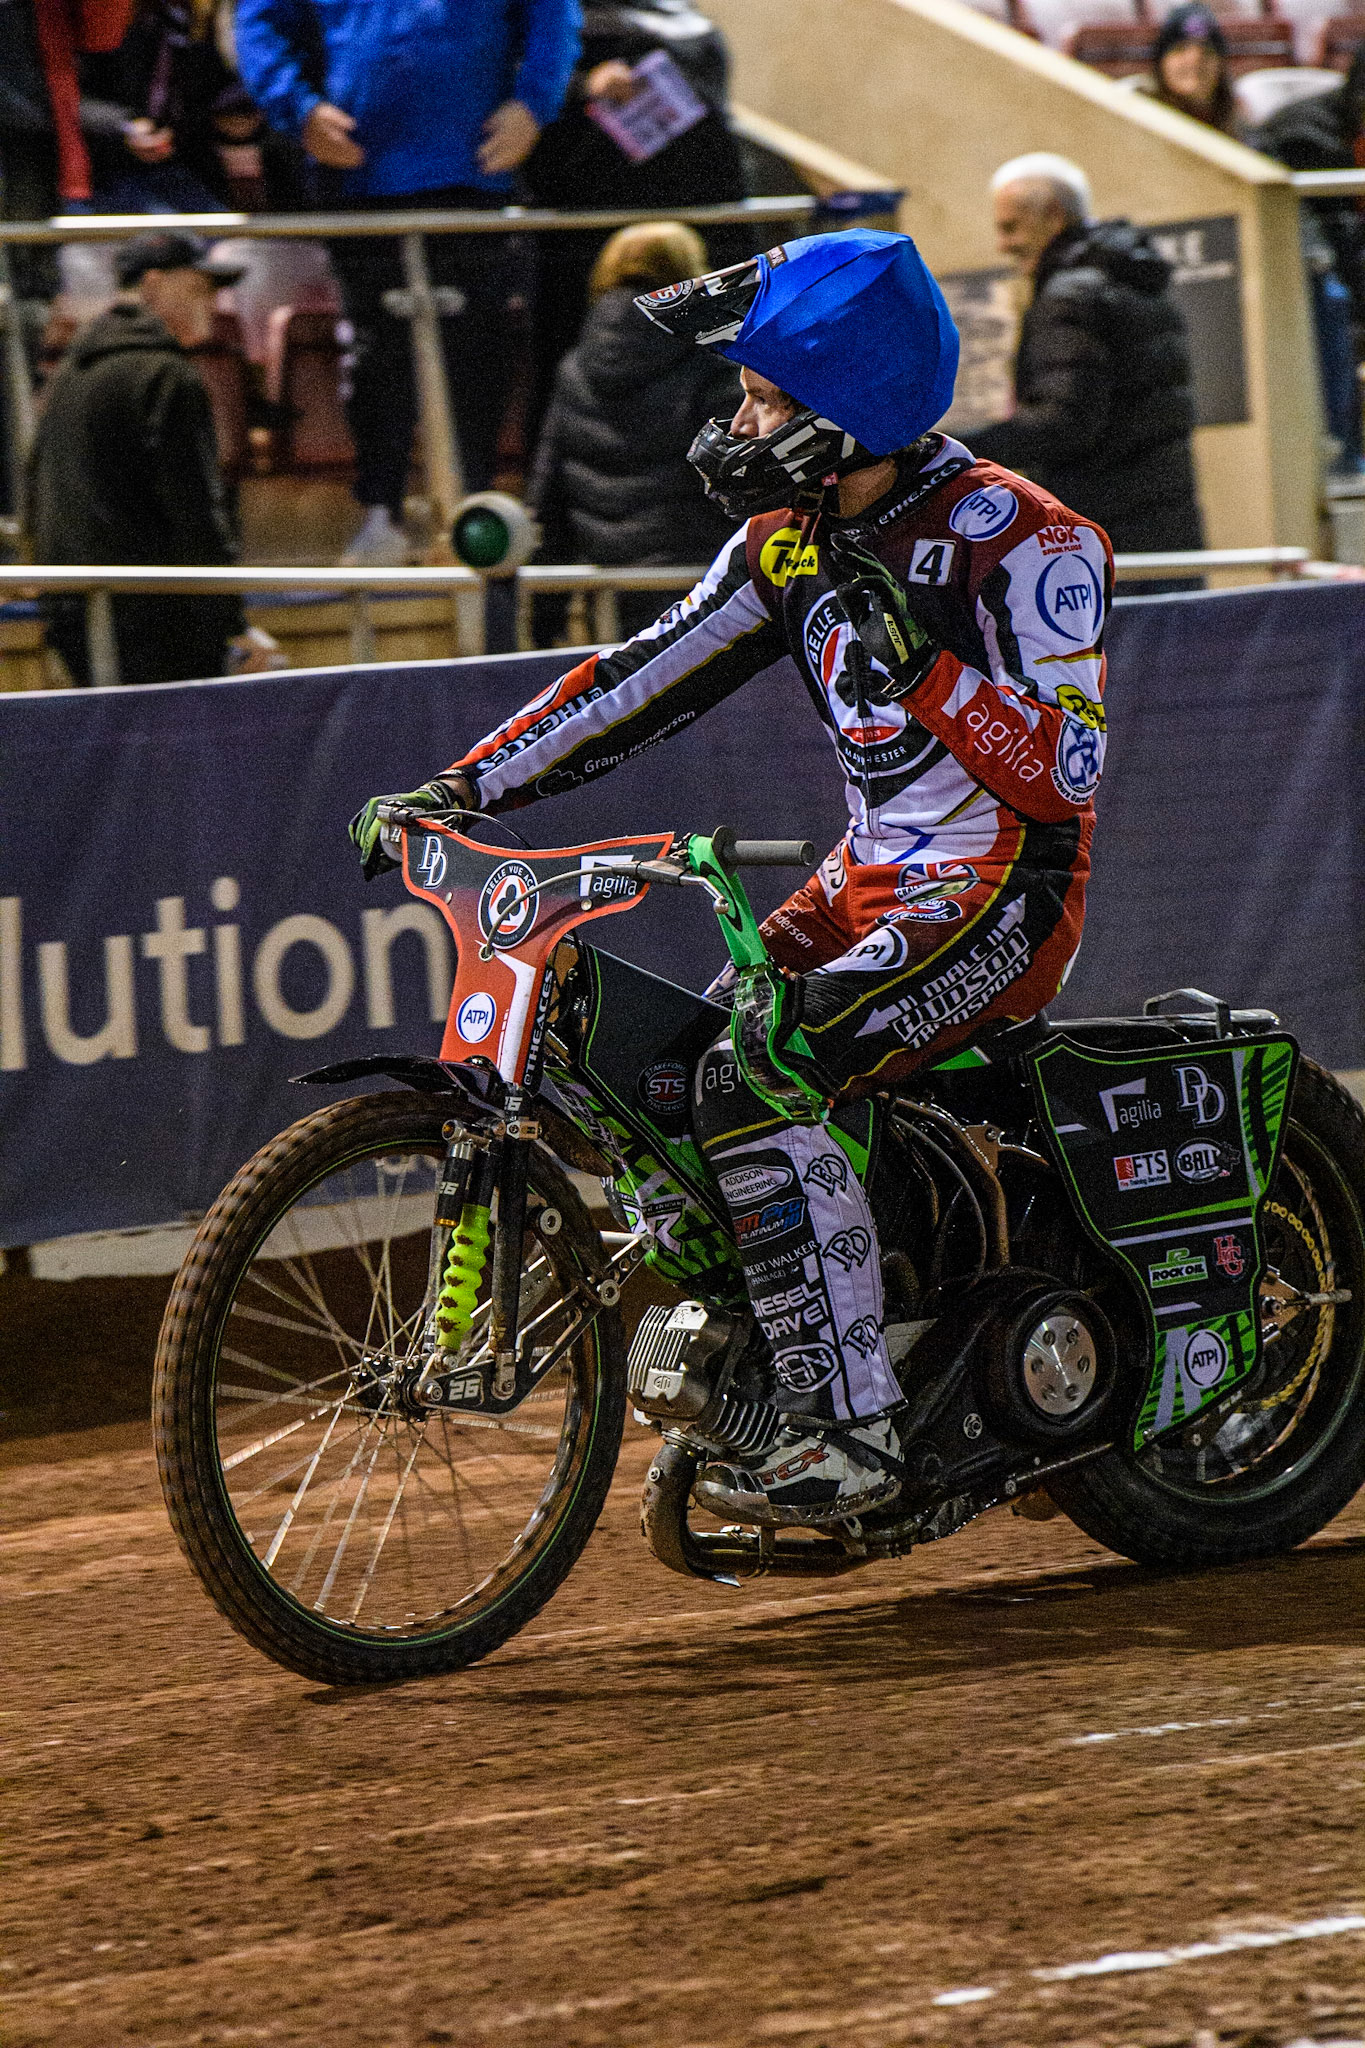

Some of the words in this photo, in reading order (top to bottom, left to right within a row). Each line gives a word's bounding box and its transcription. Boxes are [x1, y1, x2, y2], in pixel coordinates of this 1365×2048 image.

[1035, 525, 1081, 549] NGK
[915, 544, 946, 585] 4
[1054, 582, 1093, 615] ATPI
[808, 606, 836, 665] BELLE
[966, 702, 1045, 783] agilia
[584, 751, 625, 773] Grant
[485, 868, 507, 895] BELLE
[508, 865, 524, 876] VUE
[592, 875, 638, 900] agilia
[463, 1009, 490, 1025] ATPI
[648, 1077, 688, 1095] STS
[1119, 1101, 1163, 1129] agilia
[724, 1168, 765, 1187] ADDISON
[1131, 1151, 1168, 1178] FTS
[767, 1239, 820, 1269] WALKER
[1152, 1267, 1186, 1281] ROCK
[1185, 1262, 1205, 1276] OIL
[760, 1302, 824, 1341] DAVE
[1190, 1348, 1218, 1370] ATPI
